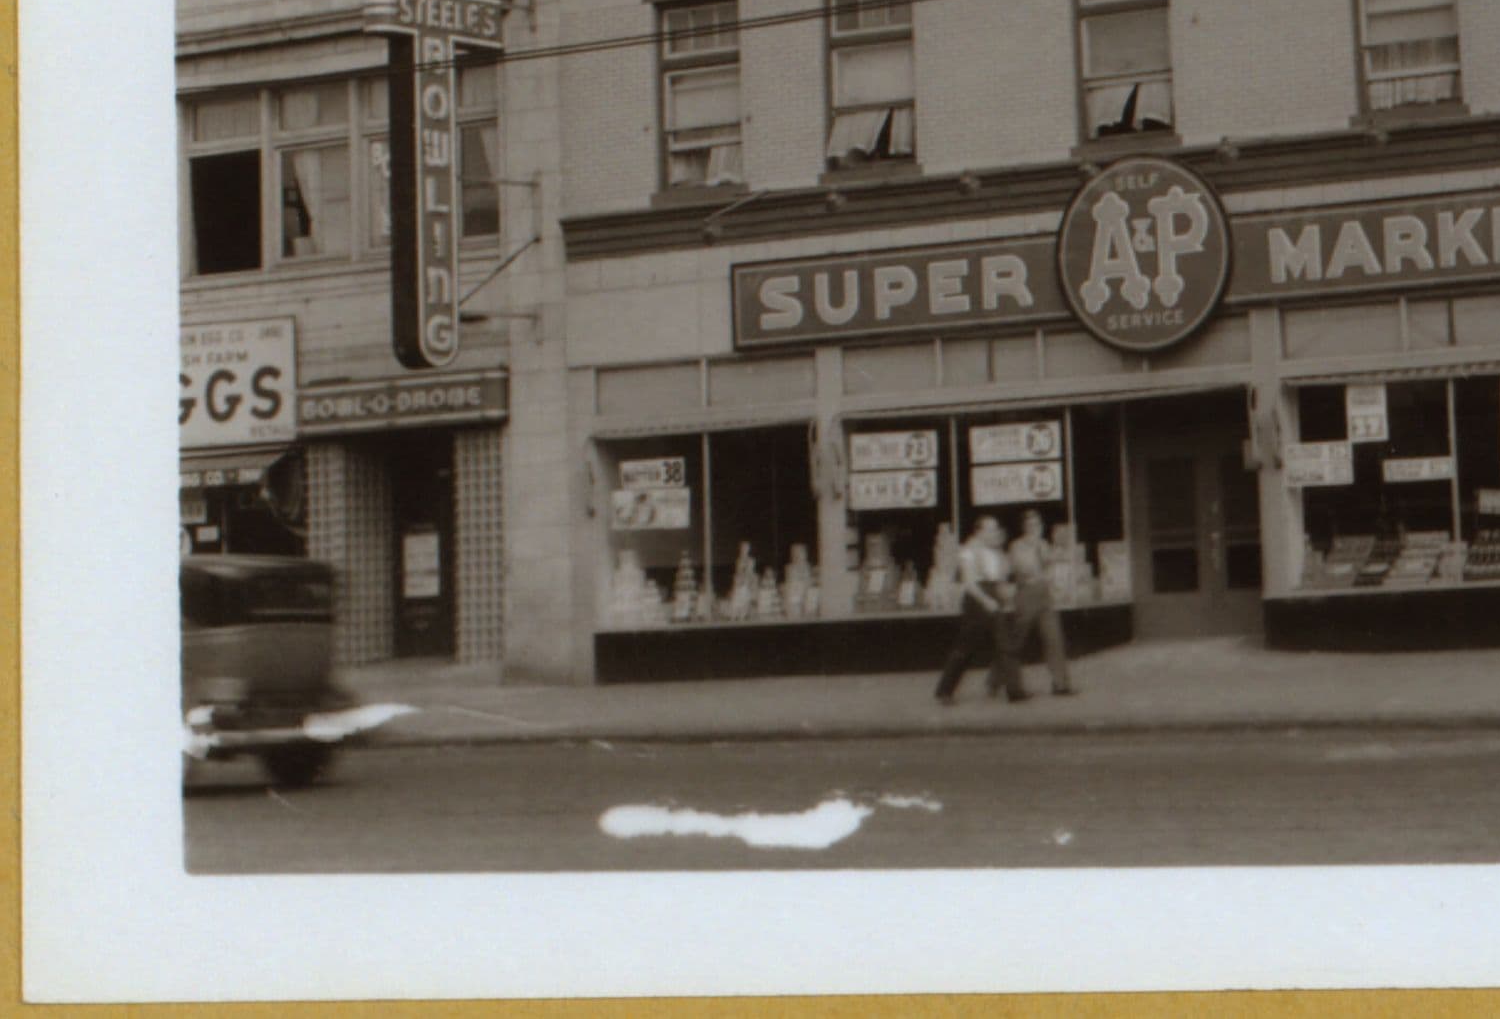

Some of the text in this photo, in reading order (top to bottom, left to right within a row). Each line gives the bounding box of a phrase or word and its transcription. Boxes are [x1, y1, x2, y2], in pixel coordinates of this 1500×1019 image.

[424, 38, 453, 352] BOWLING
[1114, 171, 1160, 192] SELF
[1079, 185, 1211, 314] A&P
[758, 254, 1034, 331] SUPER
[1106, 308, 1185, 331] SERVICE
